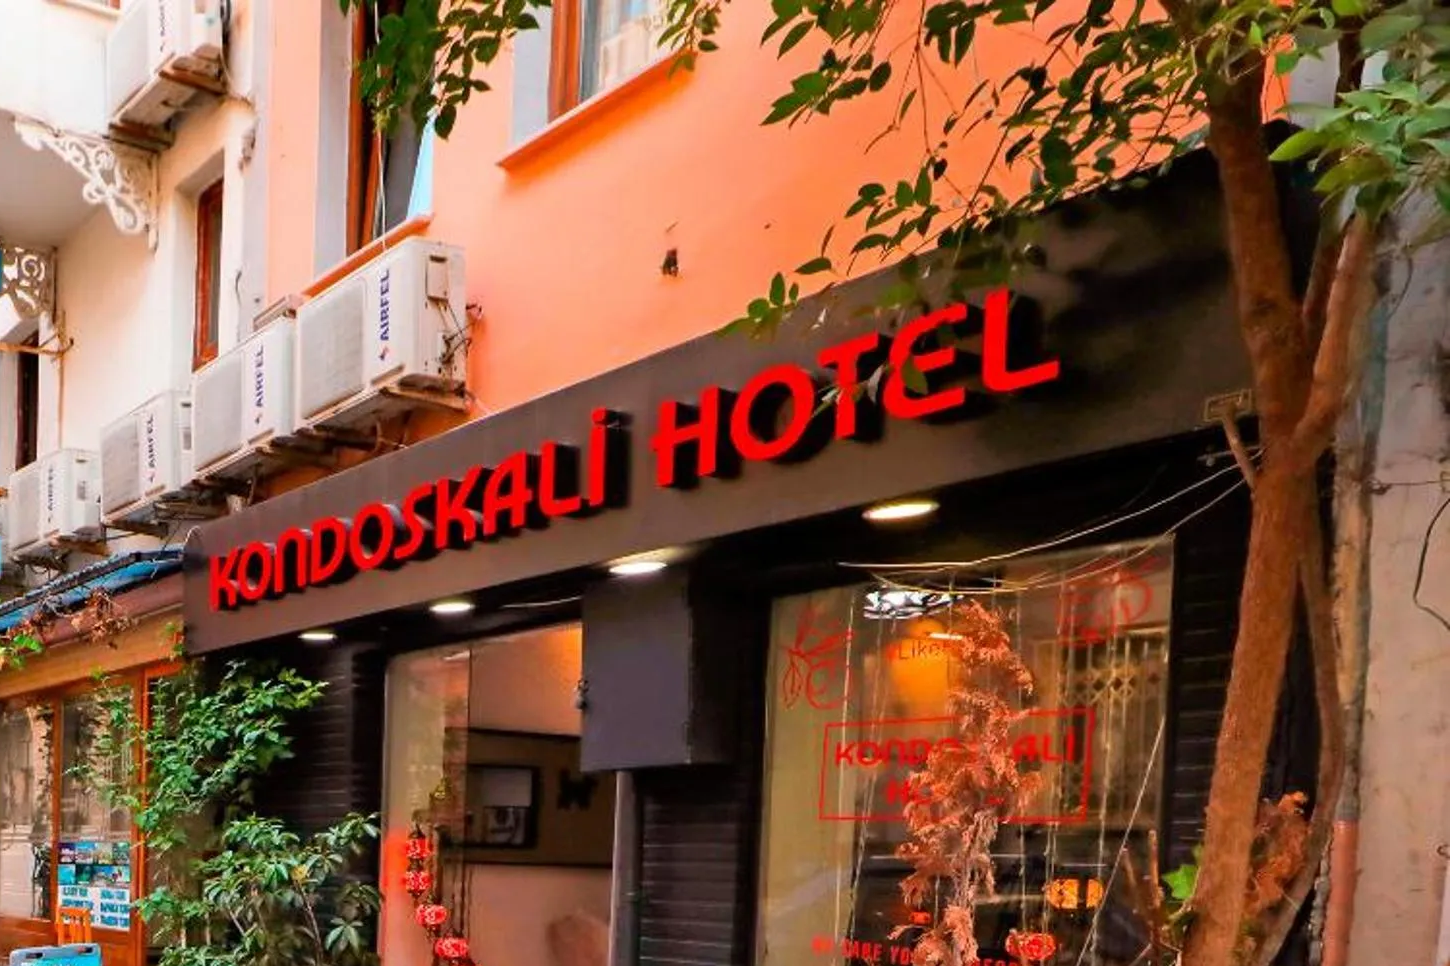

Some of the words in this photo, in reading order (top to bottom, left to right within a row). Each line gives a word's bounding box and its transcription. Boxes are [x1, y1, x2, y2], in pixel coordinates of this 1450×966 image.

[379, 268, 390, 341] AIRFEL
[255, 344, 264, 408] AIRFEL
[652, 286, 1060, 487] HOTEL
